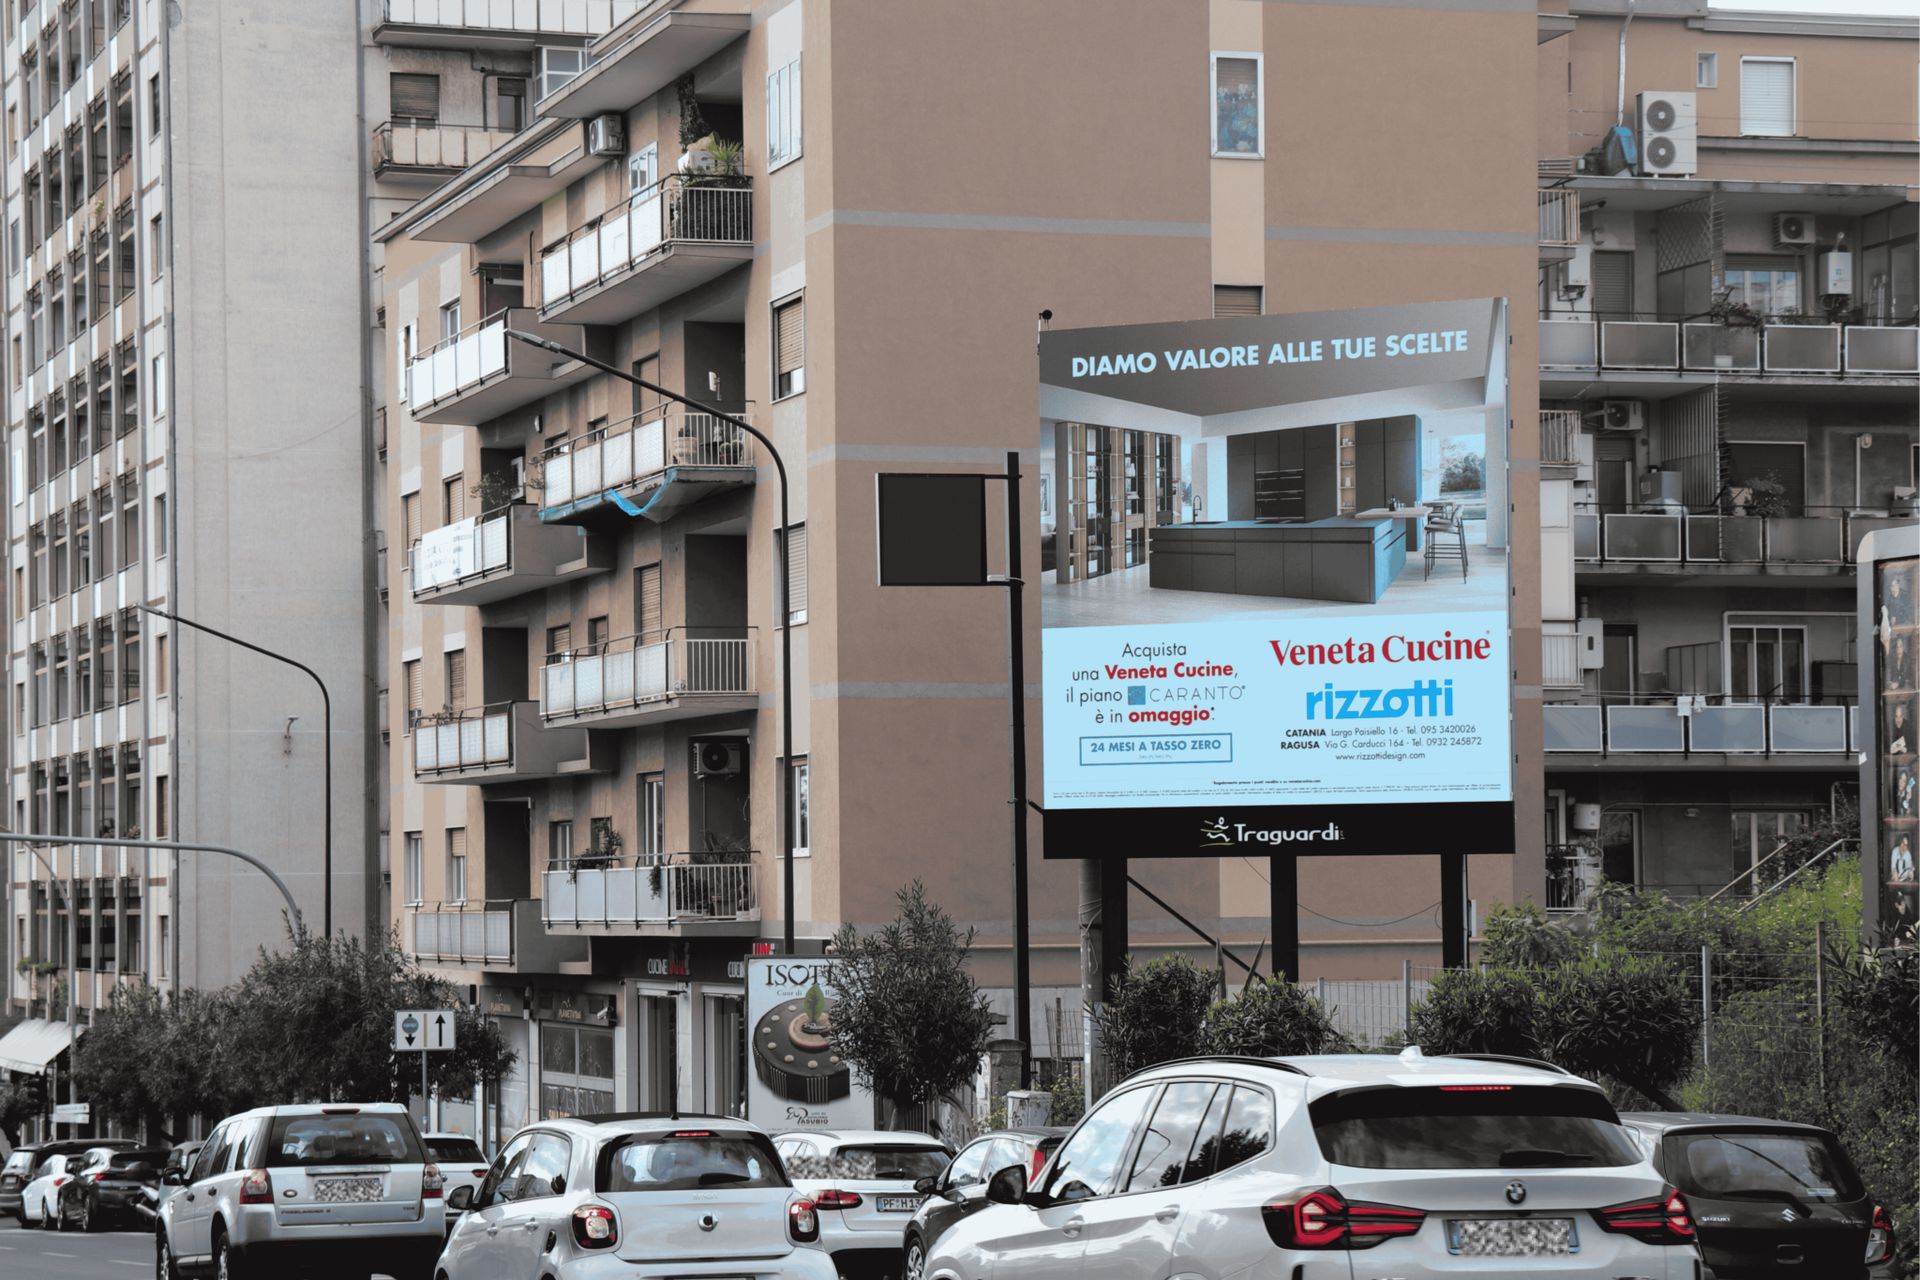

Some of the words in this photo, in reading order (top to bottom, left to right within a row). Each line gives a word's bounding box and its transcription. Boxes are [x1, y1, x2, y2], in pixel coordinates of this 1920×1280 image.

[1072, 352, 1157, 378] DIAMO
[1164, 345, 1259, 371] VALORE
[1267, 341, 1323, 365] ALLE
[1331, 336, 1376, 360] TUE
[1384, 330, 1467, 355] SCELTE
[1121, 642, 1187, 661] Acquista
[1268, 637, 1375, 666] Veneta
[1382, 630, 1491, 663] Cucine
[1072, 670, 1100, 681] una
[1105, 664, 1168, 680] Veneta
[1173, 660, 1238, 679] Cucine,
[1066, 686, 1074, 703] il
[1079, 687, 1123, 707] piano
[1306, 679, 1454, 721] rizzotti
[1095, 709, 1104, 724] è
[1110, 709, 1123, 723] in
[1285, 728, 1326, 737] CATANIA
[1331, 728, 1353, 738] Largo
[1354, 726, 1386, 736] Paisiello
[1388, 727, 1398, 736] 16
[1406, 726, 1418, 735] Tel.
[1420, 726, 1437, 735] 095
[1439, 724, 1476, 734] 3420026
[1090, 742, 1105, 753] 24
[1108, 741, 1135, 752] MESI
[1138, 741, 1148, 751] A
[1150, 740, 1188, 751] TASSO
[1190, 739, 1222, 750] ZERO
[1280, 740, 1320, 750] RAGUSA
[1324, 740, 1338, 749] Via
[1338, 739, 1349, 749] G.
[1352, 739, 1386, 748] Carducci
[1388, 739, 1405, 748] 164
[1411, 738, 1424, 748] Tel.
[1426, 738, 1448, 747] 0932
[1450, 736, 1482, 747] 245872
[1335, 752, 1426, 761] www.rizzottidesign.com
[1234, 822, 1340, 845] Traguardi
[883, 1199, 895, 1208] PF
